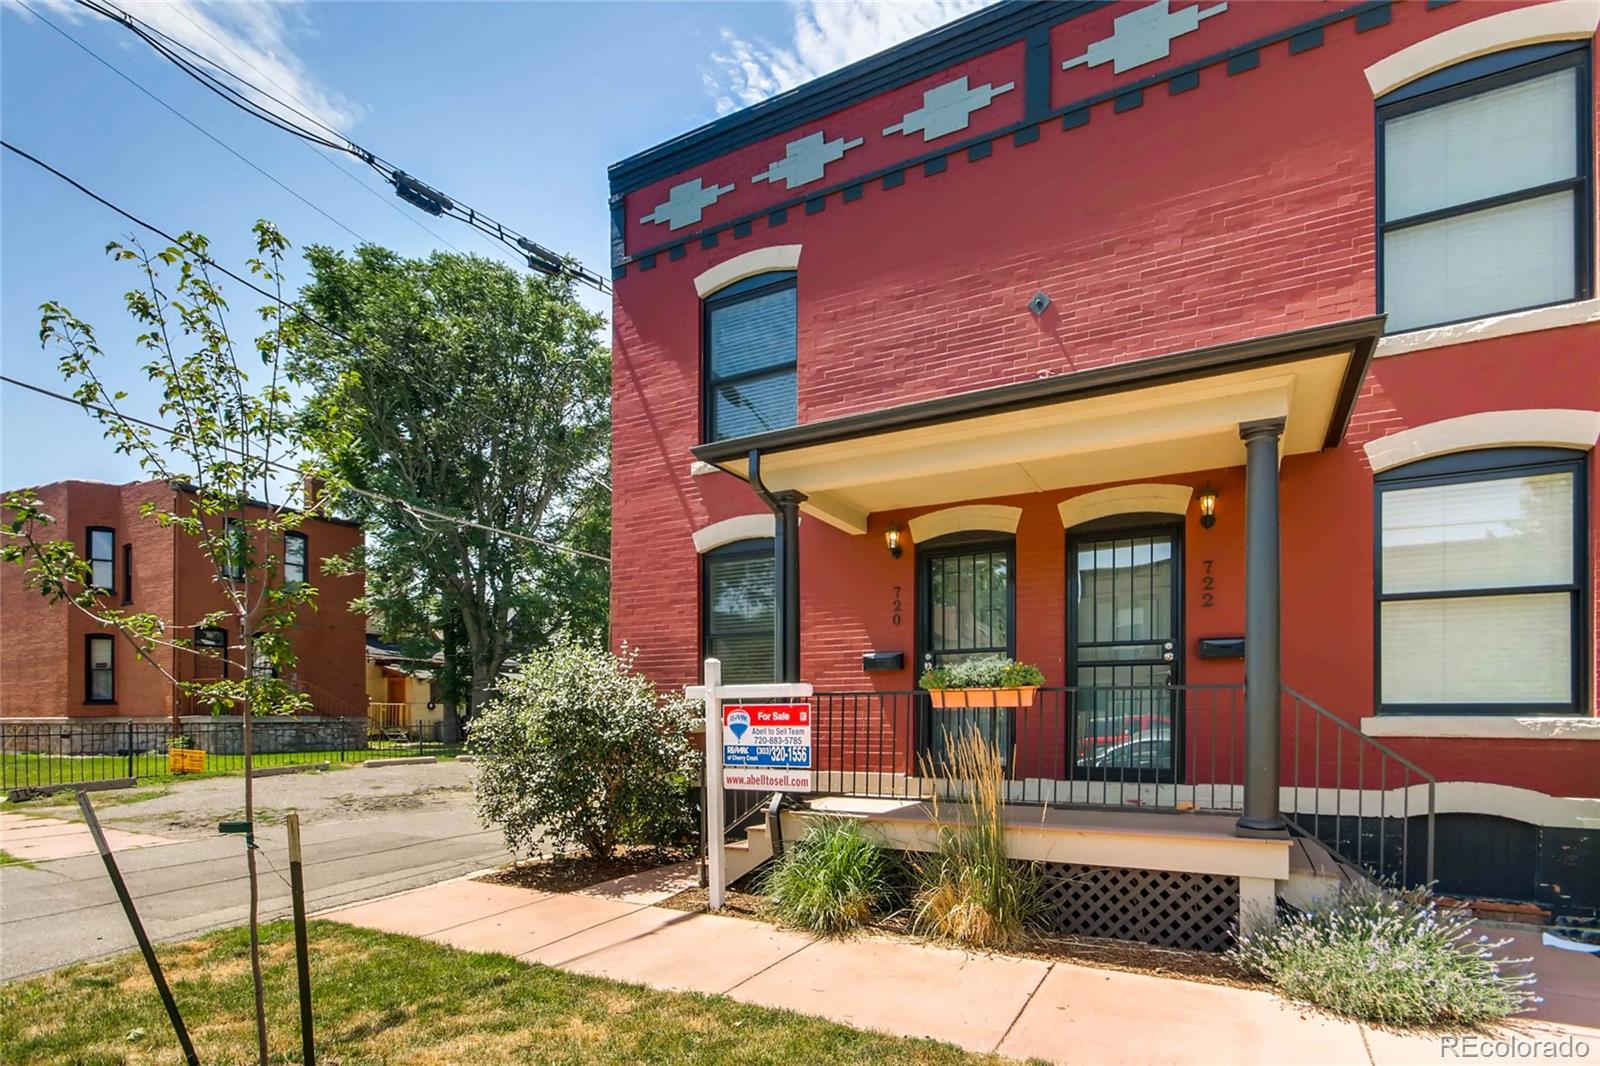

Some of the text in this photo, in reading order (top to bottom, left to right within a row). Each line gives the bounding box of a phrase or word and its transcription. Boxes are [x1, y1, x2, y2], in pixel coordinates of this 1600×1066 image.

[1201, 560, 1214, 608] 722
[892, 585, 902, 625] 720
[757, 711, 771, 721] For
[772, 711, 790, 721] Sale
[751, 727, 767, 735] Abell
[776, 727, 787, 735] Sell
[788, 727, 805, 735] Team
[771, 746, 807, 762] 320-1556
[726, 774, 809, 787] www.abelltosell.com
